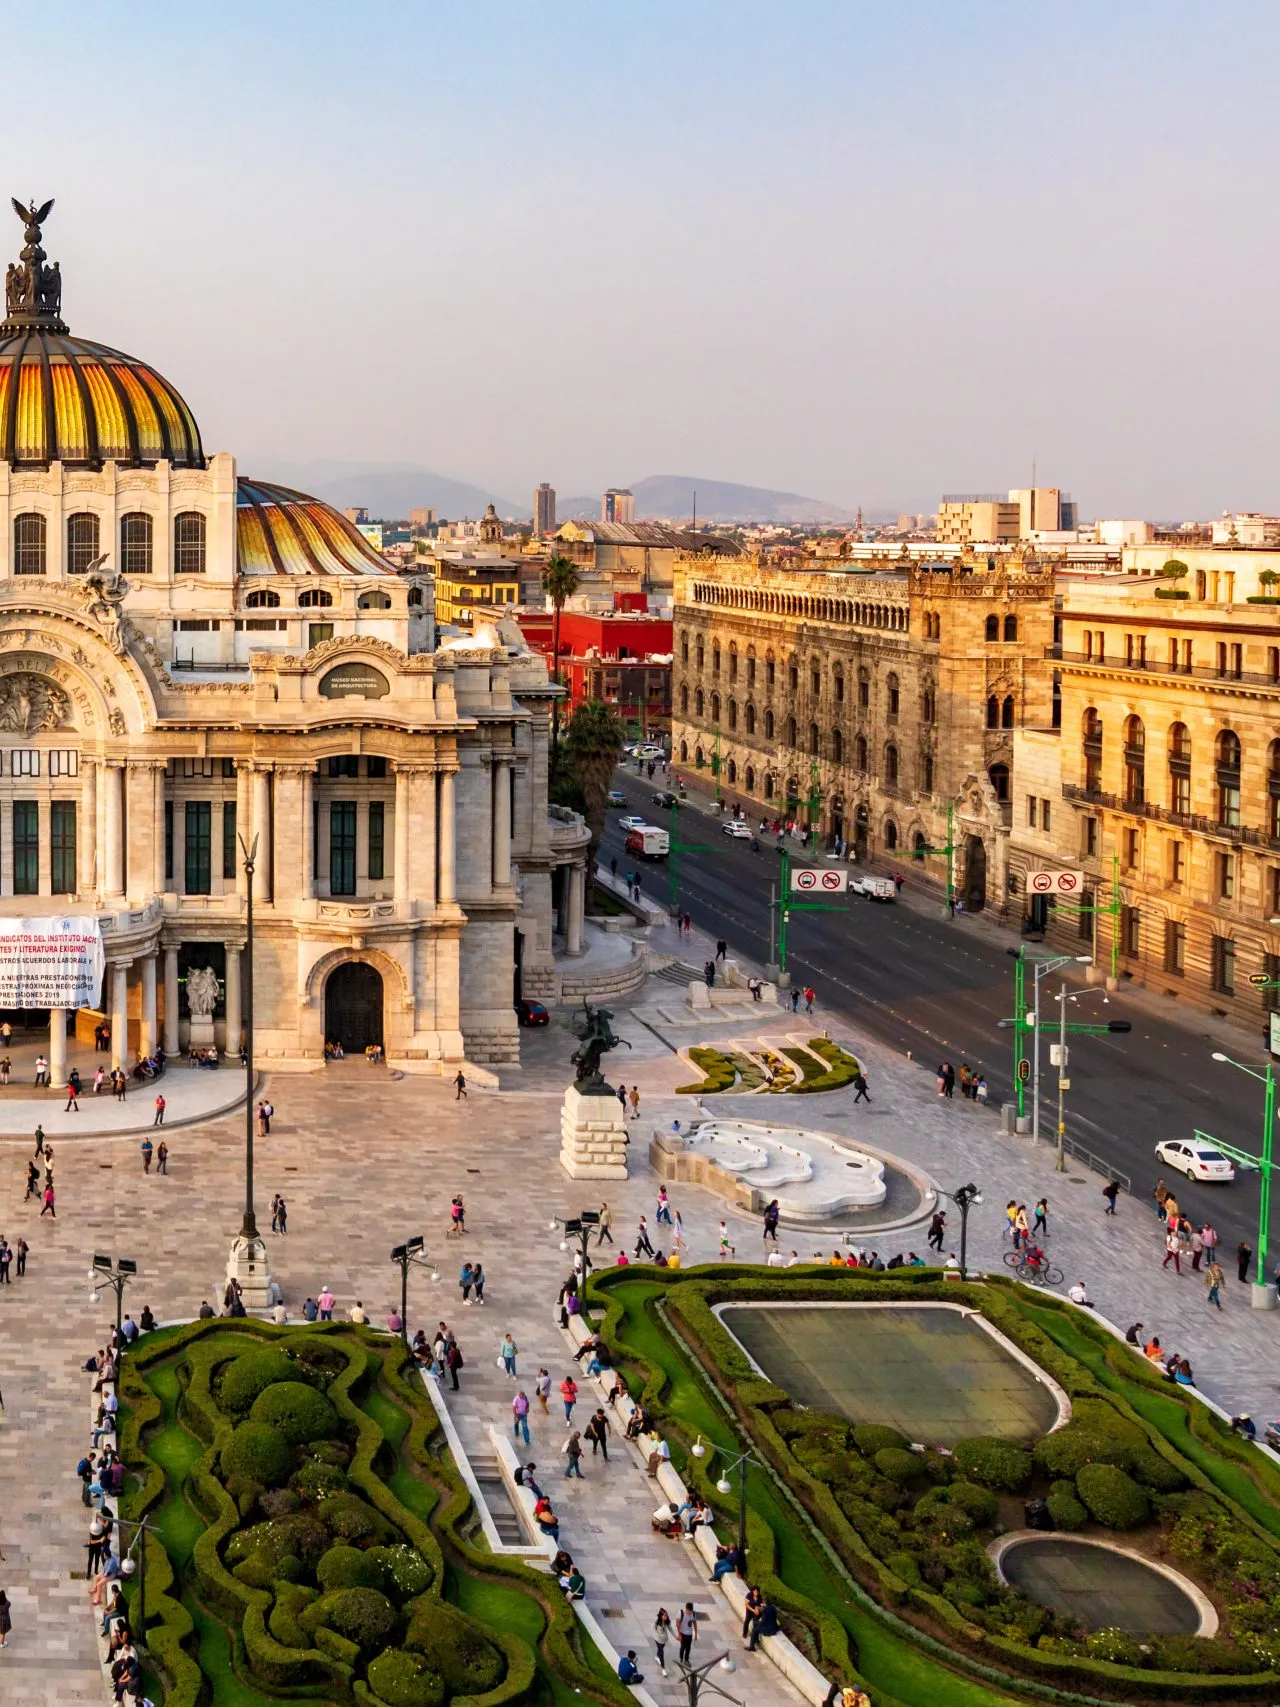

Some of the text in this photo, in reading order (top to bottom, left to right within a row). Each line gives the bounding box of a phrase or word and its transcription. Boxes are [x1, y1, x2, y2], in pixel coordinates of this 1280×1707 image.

[17, 660, 69, 683] BELLAS
[72, 686, 94, 727] ARTES
[48, 934, 81, 942] INSTITUTO
[20, 945, 58, 953] LITERATURA
